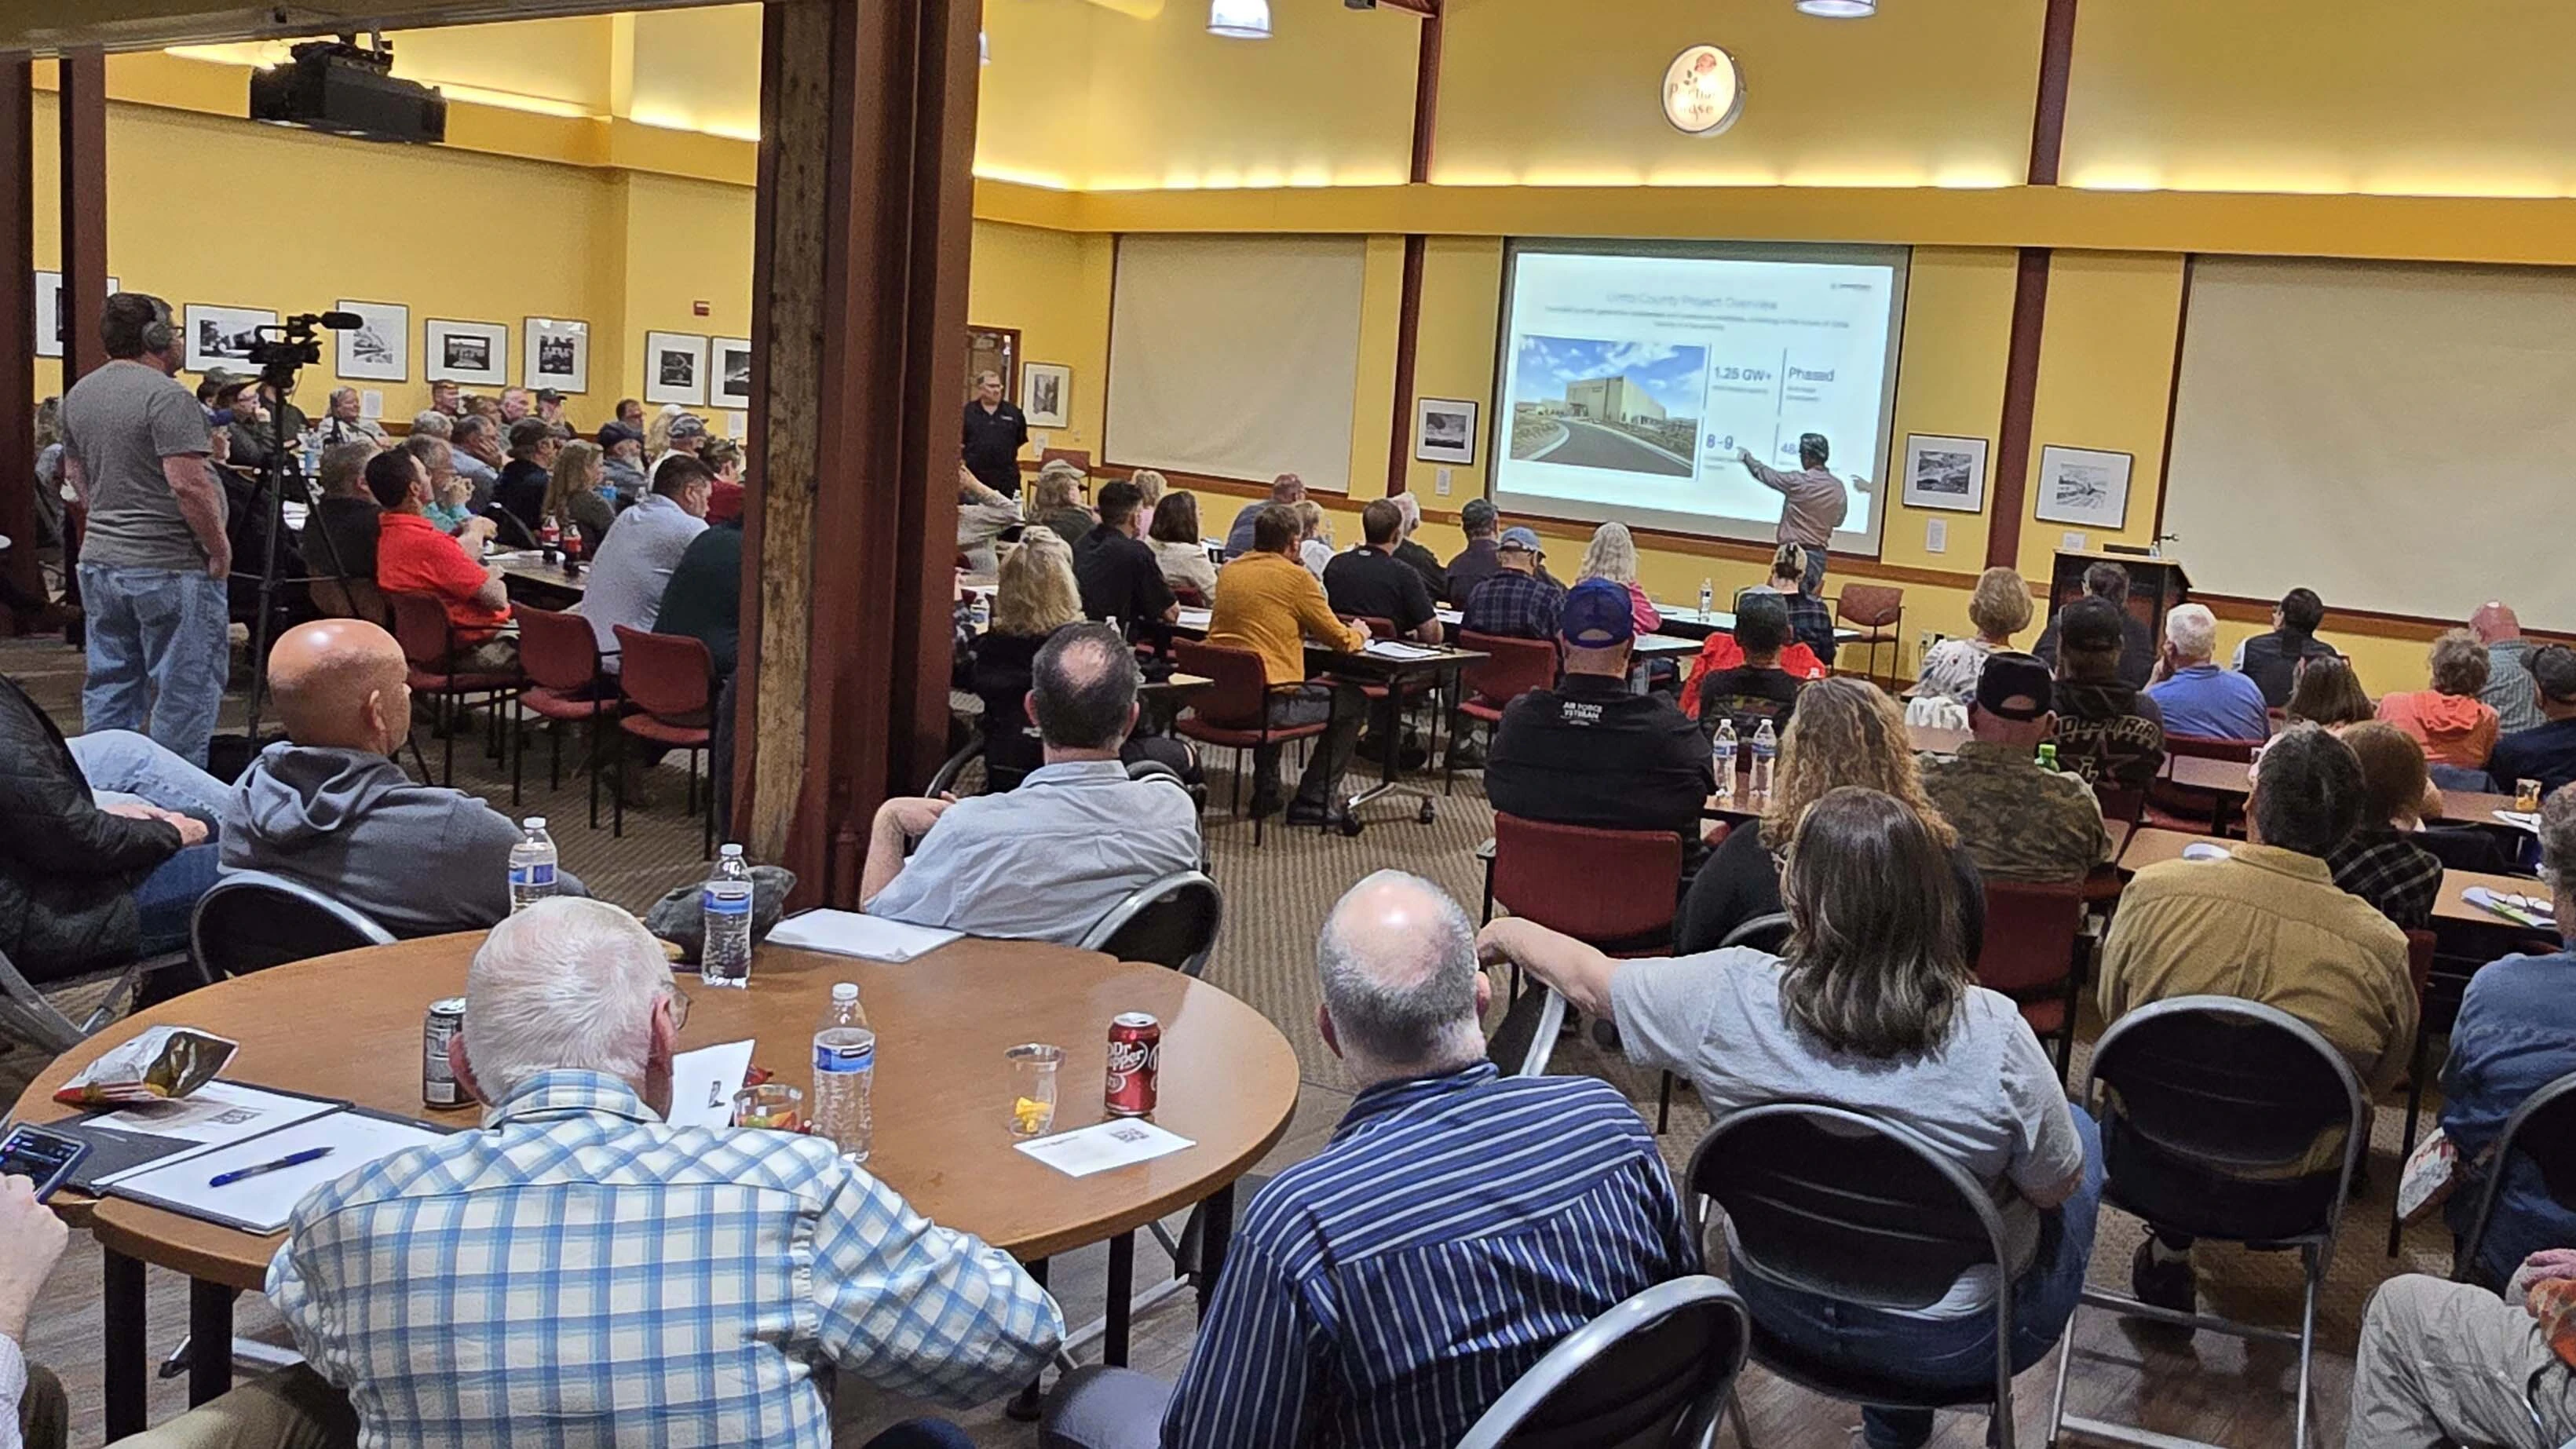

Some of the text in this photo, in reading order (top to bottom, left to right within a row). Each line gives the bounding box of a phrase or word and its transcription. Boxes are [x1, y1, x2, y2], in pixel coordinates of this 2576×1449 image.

[1715, 367, 1740, 380] 1.25
[1562, 701, 1602, 714] AIR FORCE
[1564, 709, 1599, 720] VETERAN
[1113, 1041, 1132, 1057] Dr
[1106, 1049, 1145, 1071] pper
